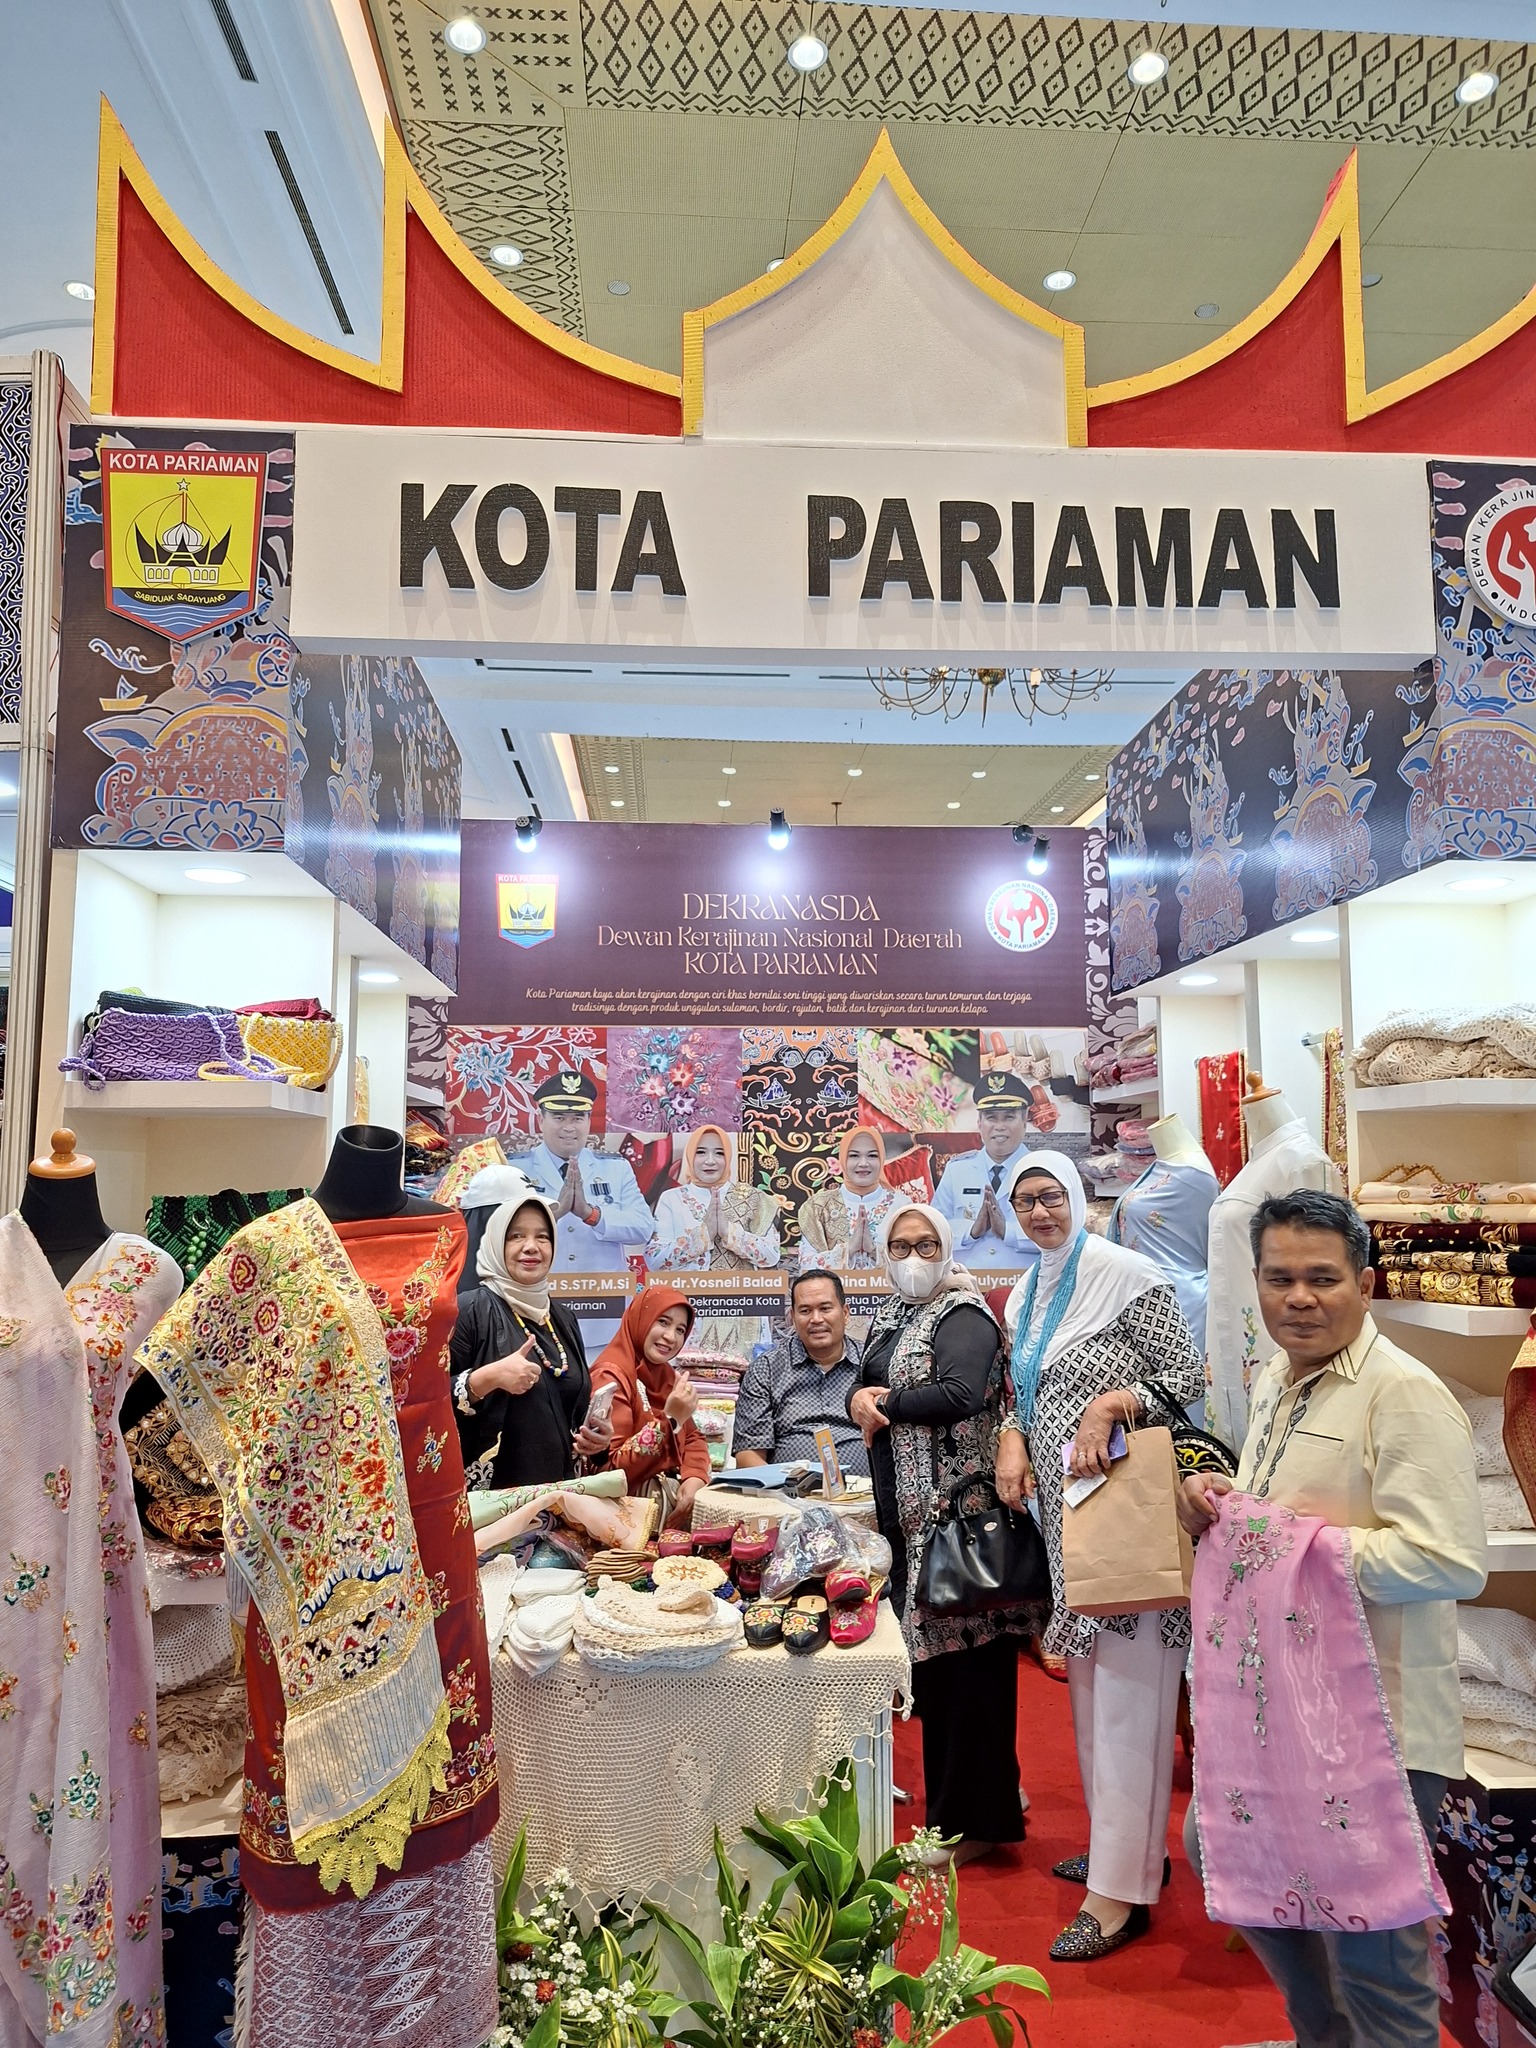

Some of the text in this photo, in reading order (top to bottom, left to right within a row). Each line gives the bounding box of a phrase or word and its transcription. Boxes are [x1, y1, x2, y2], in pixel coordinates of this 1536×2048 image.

[109, 453, 260, 473] KOTA PARIAMAN
[400, 483, 1341, 609] KOTA PARIAMAN
[1471, 534, 1489, 588] DEWAN
[134, 590, 227, 604] SABIDUAK SADAYUANG
[682, 892, 881, 922] DEKRANASDA
[598, 925, 963, 954] Dewan Kerajinan Nasional Daerah
[684, 951, 879, 976] KOTA PARIAMAN
[526, 988, 1032, 1005] Kota Pariaman kaya akan kerajinan dengan ciri khas bernilai seni tinggi yang diwariskan secara turun temurun dan terjaga
[572, 1002, 615, 1014] tradisinya
[617, 1002, 649, 1015] dengan
[650, 1002, 681, 1014] produk
[682, 1003, 721, 1015] unggulan
[827, 1003, 848, 1014] batik
[849, 1004, 865, 1014] dan
[867, 1003, 906, 1017] kerajinan
[907, 1004, 925, 1014] dari
[926, 1004, 959, 1014] turunan
[961, 1004, 989, 1016] kelapa
[560, 1278, 630, 1292] S.STP,M.Si
[743, 1276, 783, 1288] Balad
[688, 1296, 781, 1307] Dekranasda Kota
